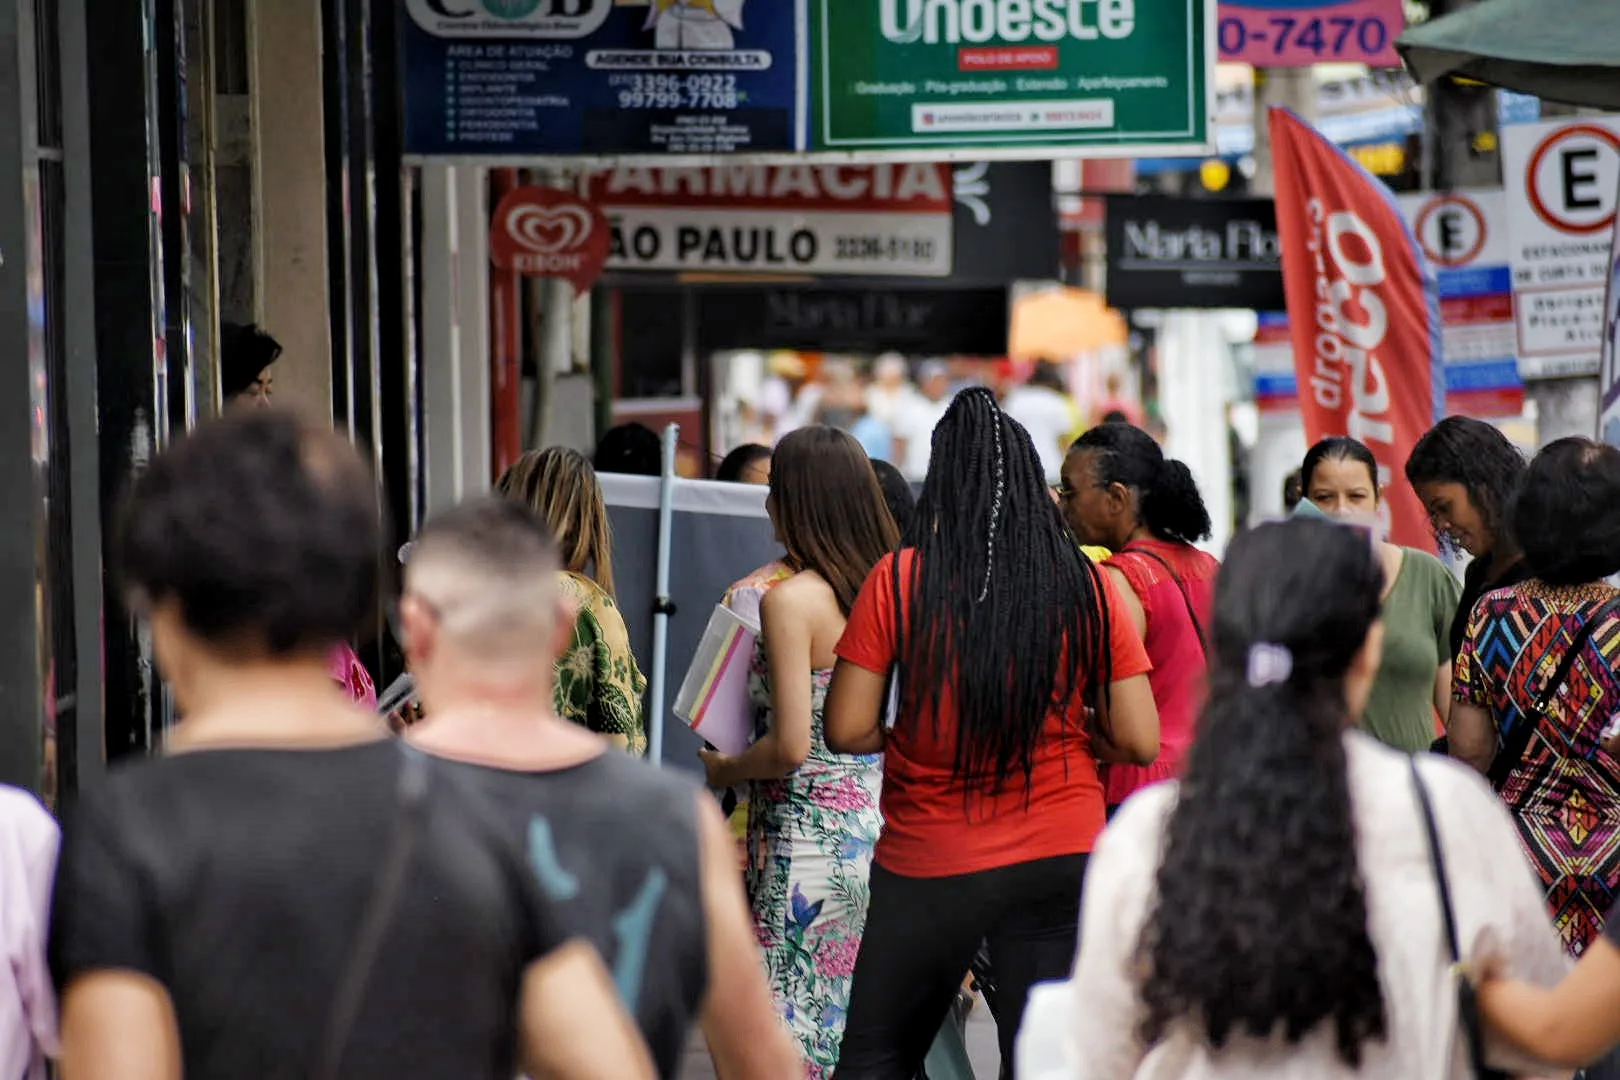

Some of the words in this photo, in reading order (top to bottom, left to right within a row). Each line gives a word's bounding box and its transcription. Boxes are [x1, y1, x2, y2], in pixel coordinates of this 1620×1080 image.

[880, 0, 1135, 44] Unoeste
[1218, 17, 1388, 56] 0-7470
[486, 45, 505, 57] DE
[688, 53, 761, 65] CONSULTA
[618, 91, 737, 109] 99799-7708
[1561, 149, 1601, 210] E
[608, 212, 661, 261] ÃO
[676, 226, 818, 264] PAULO
[1226, 219, 1283, 260] Flo
[1438, 211, 1463, 253] E
